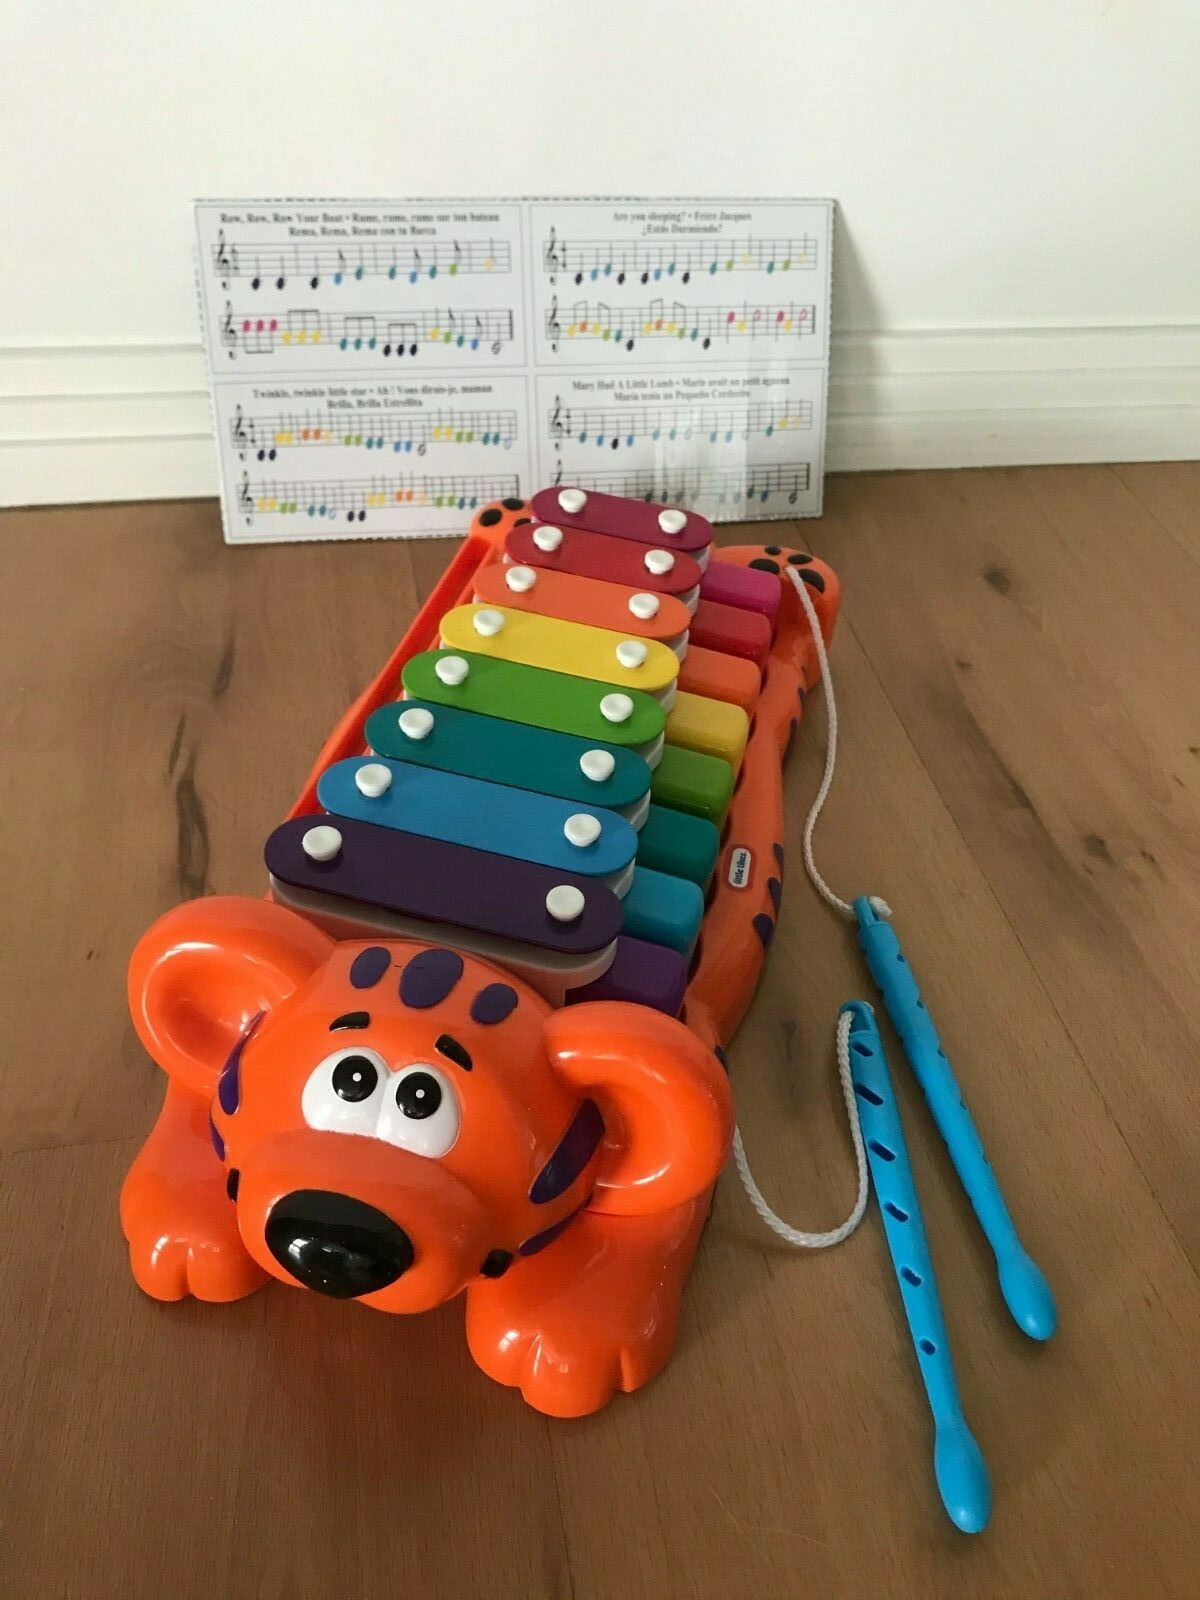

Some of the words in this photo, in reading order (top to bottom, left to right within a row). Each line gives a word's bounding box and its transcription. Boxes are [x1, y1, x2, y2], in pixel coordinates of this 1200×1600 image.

[328, 387, 347, 396] little
[736, 852, 747, 868] tikes
[733, 869, 744, 884] little
